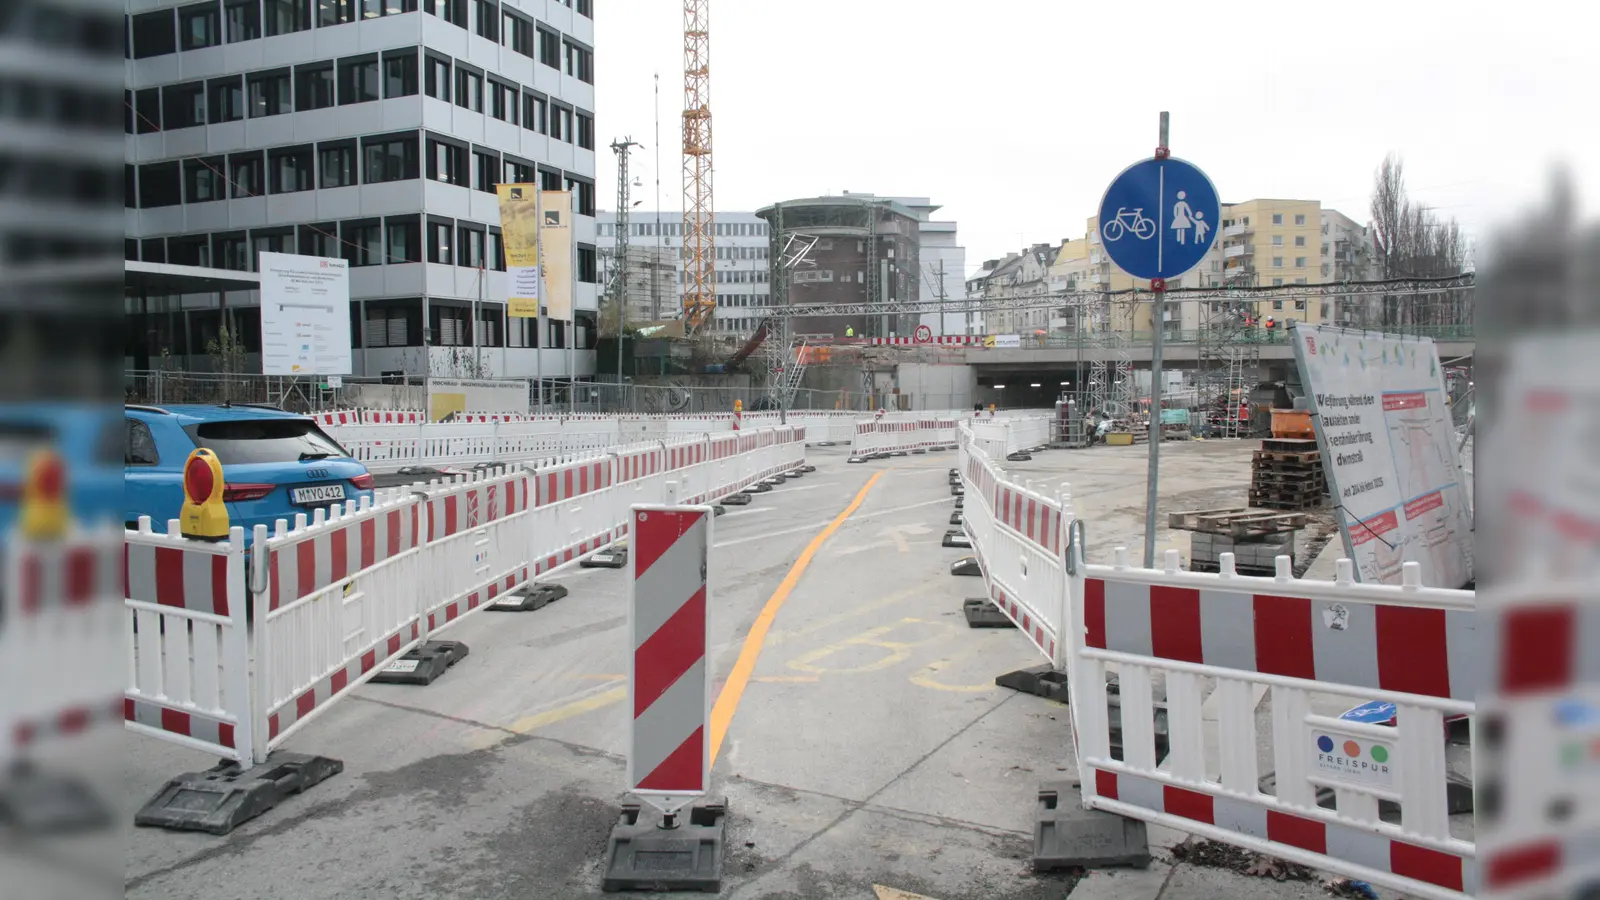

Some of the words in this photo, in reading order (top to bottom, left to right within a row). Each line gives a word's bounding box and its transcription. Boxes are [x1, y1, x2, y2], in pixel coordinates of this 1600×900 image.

[299, 490, 307, 500] M
[325, 486, 342, 498] 412
[1318, 753, 1389, 774] FREISPUR
